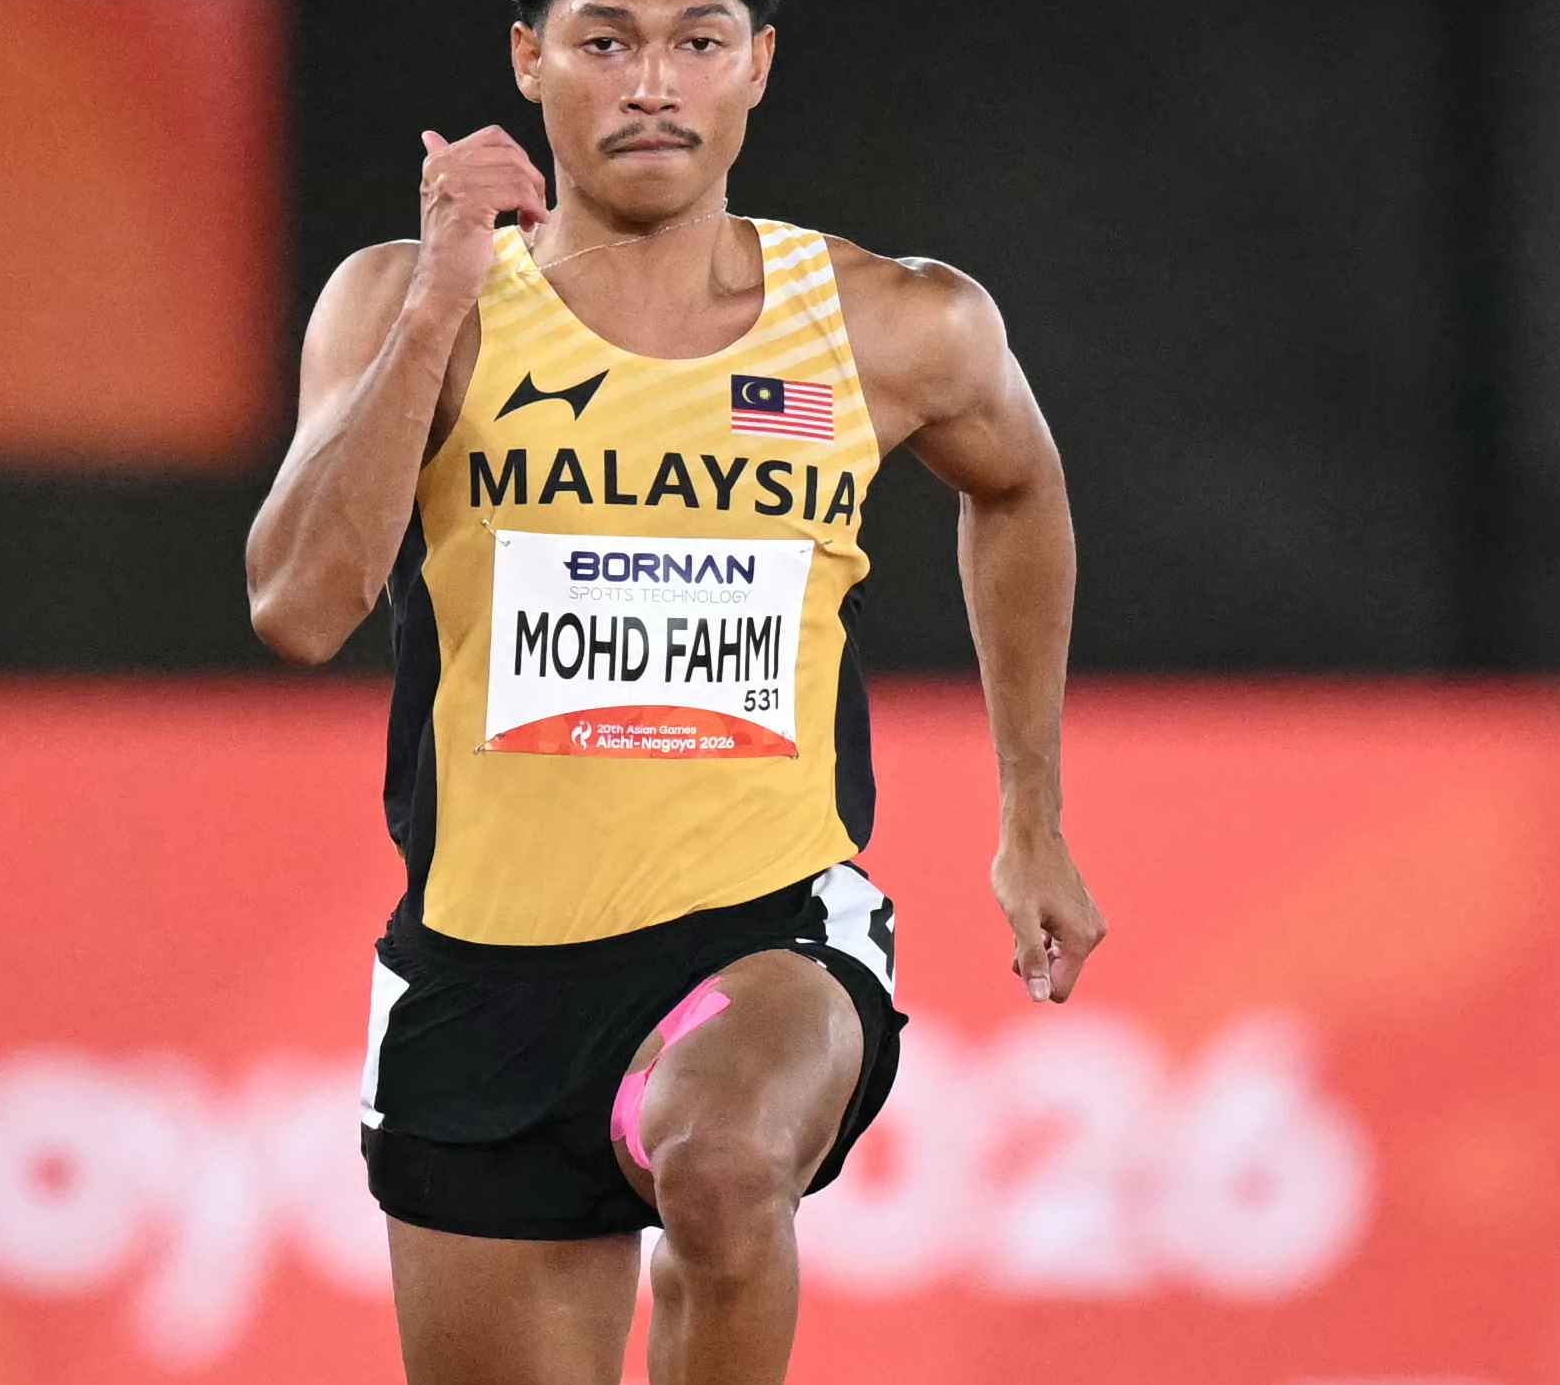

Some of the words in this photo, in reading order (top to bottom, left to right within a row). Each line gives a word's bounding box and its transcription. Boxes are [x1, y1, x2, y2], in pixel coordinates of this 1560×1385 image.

[469, 447, 856, 527] MALAYSIA
[563, 551, 755, 584] BORNAN
[569, 586, 633, 601] SPORTS
[639, 588, 752, 604] TECHNOLOGY
[514, 610, 650, 682] MOHD
[664, 614, 782, 683] FAHMI
[743, 687, 780, 712] 531
[596, 735, 697, 751] Aichi-Nagoya
[699, 736, 735, 749] 2026
[597, 724, 624, 734] 20th
[627, 724, 657, 735] Asian
[659, 725, 697, 735] Games
[807, 1004, 1372, 1299] 026
